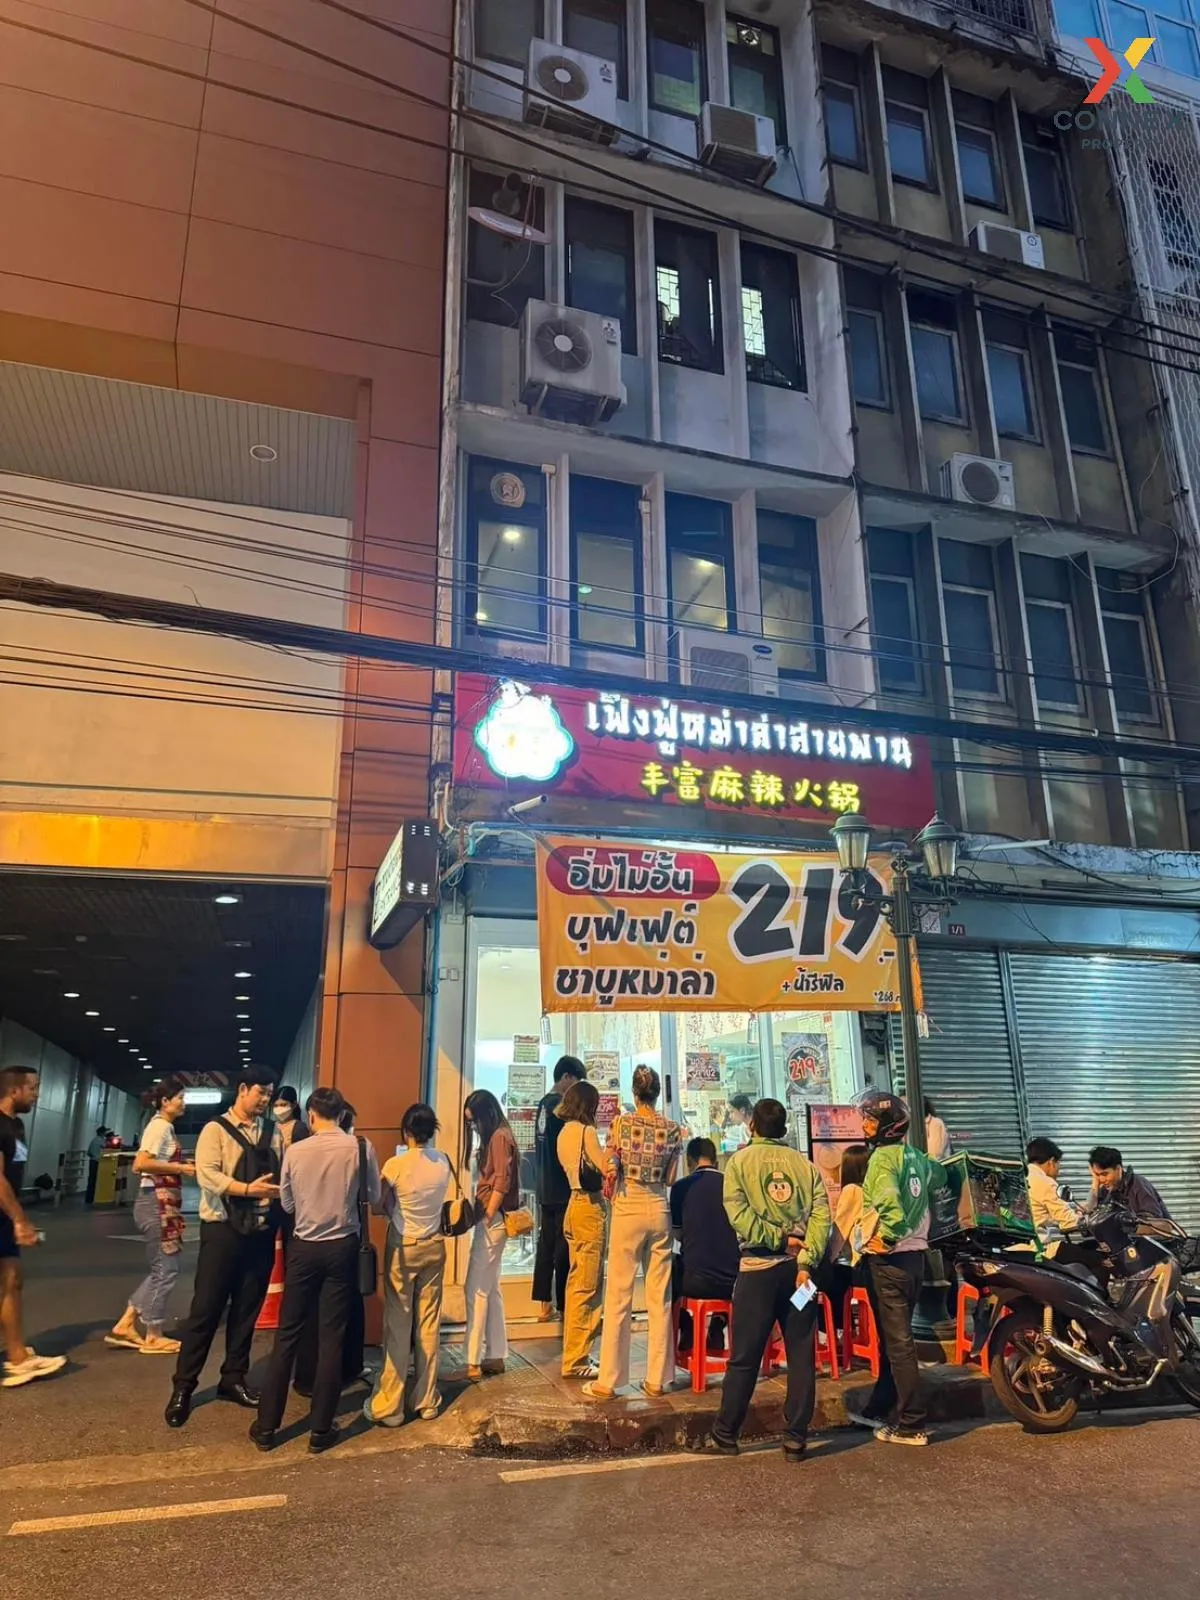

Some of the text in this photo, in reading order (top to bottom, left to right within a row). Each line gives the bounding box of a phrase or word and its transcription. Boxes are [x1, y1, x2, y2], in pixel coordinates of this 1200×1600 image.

[568, 850, 692, 894] อิ่มไม่อั้น
[556, 951, 715, 1005] ชาบูหม่าล่า
